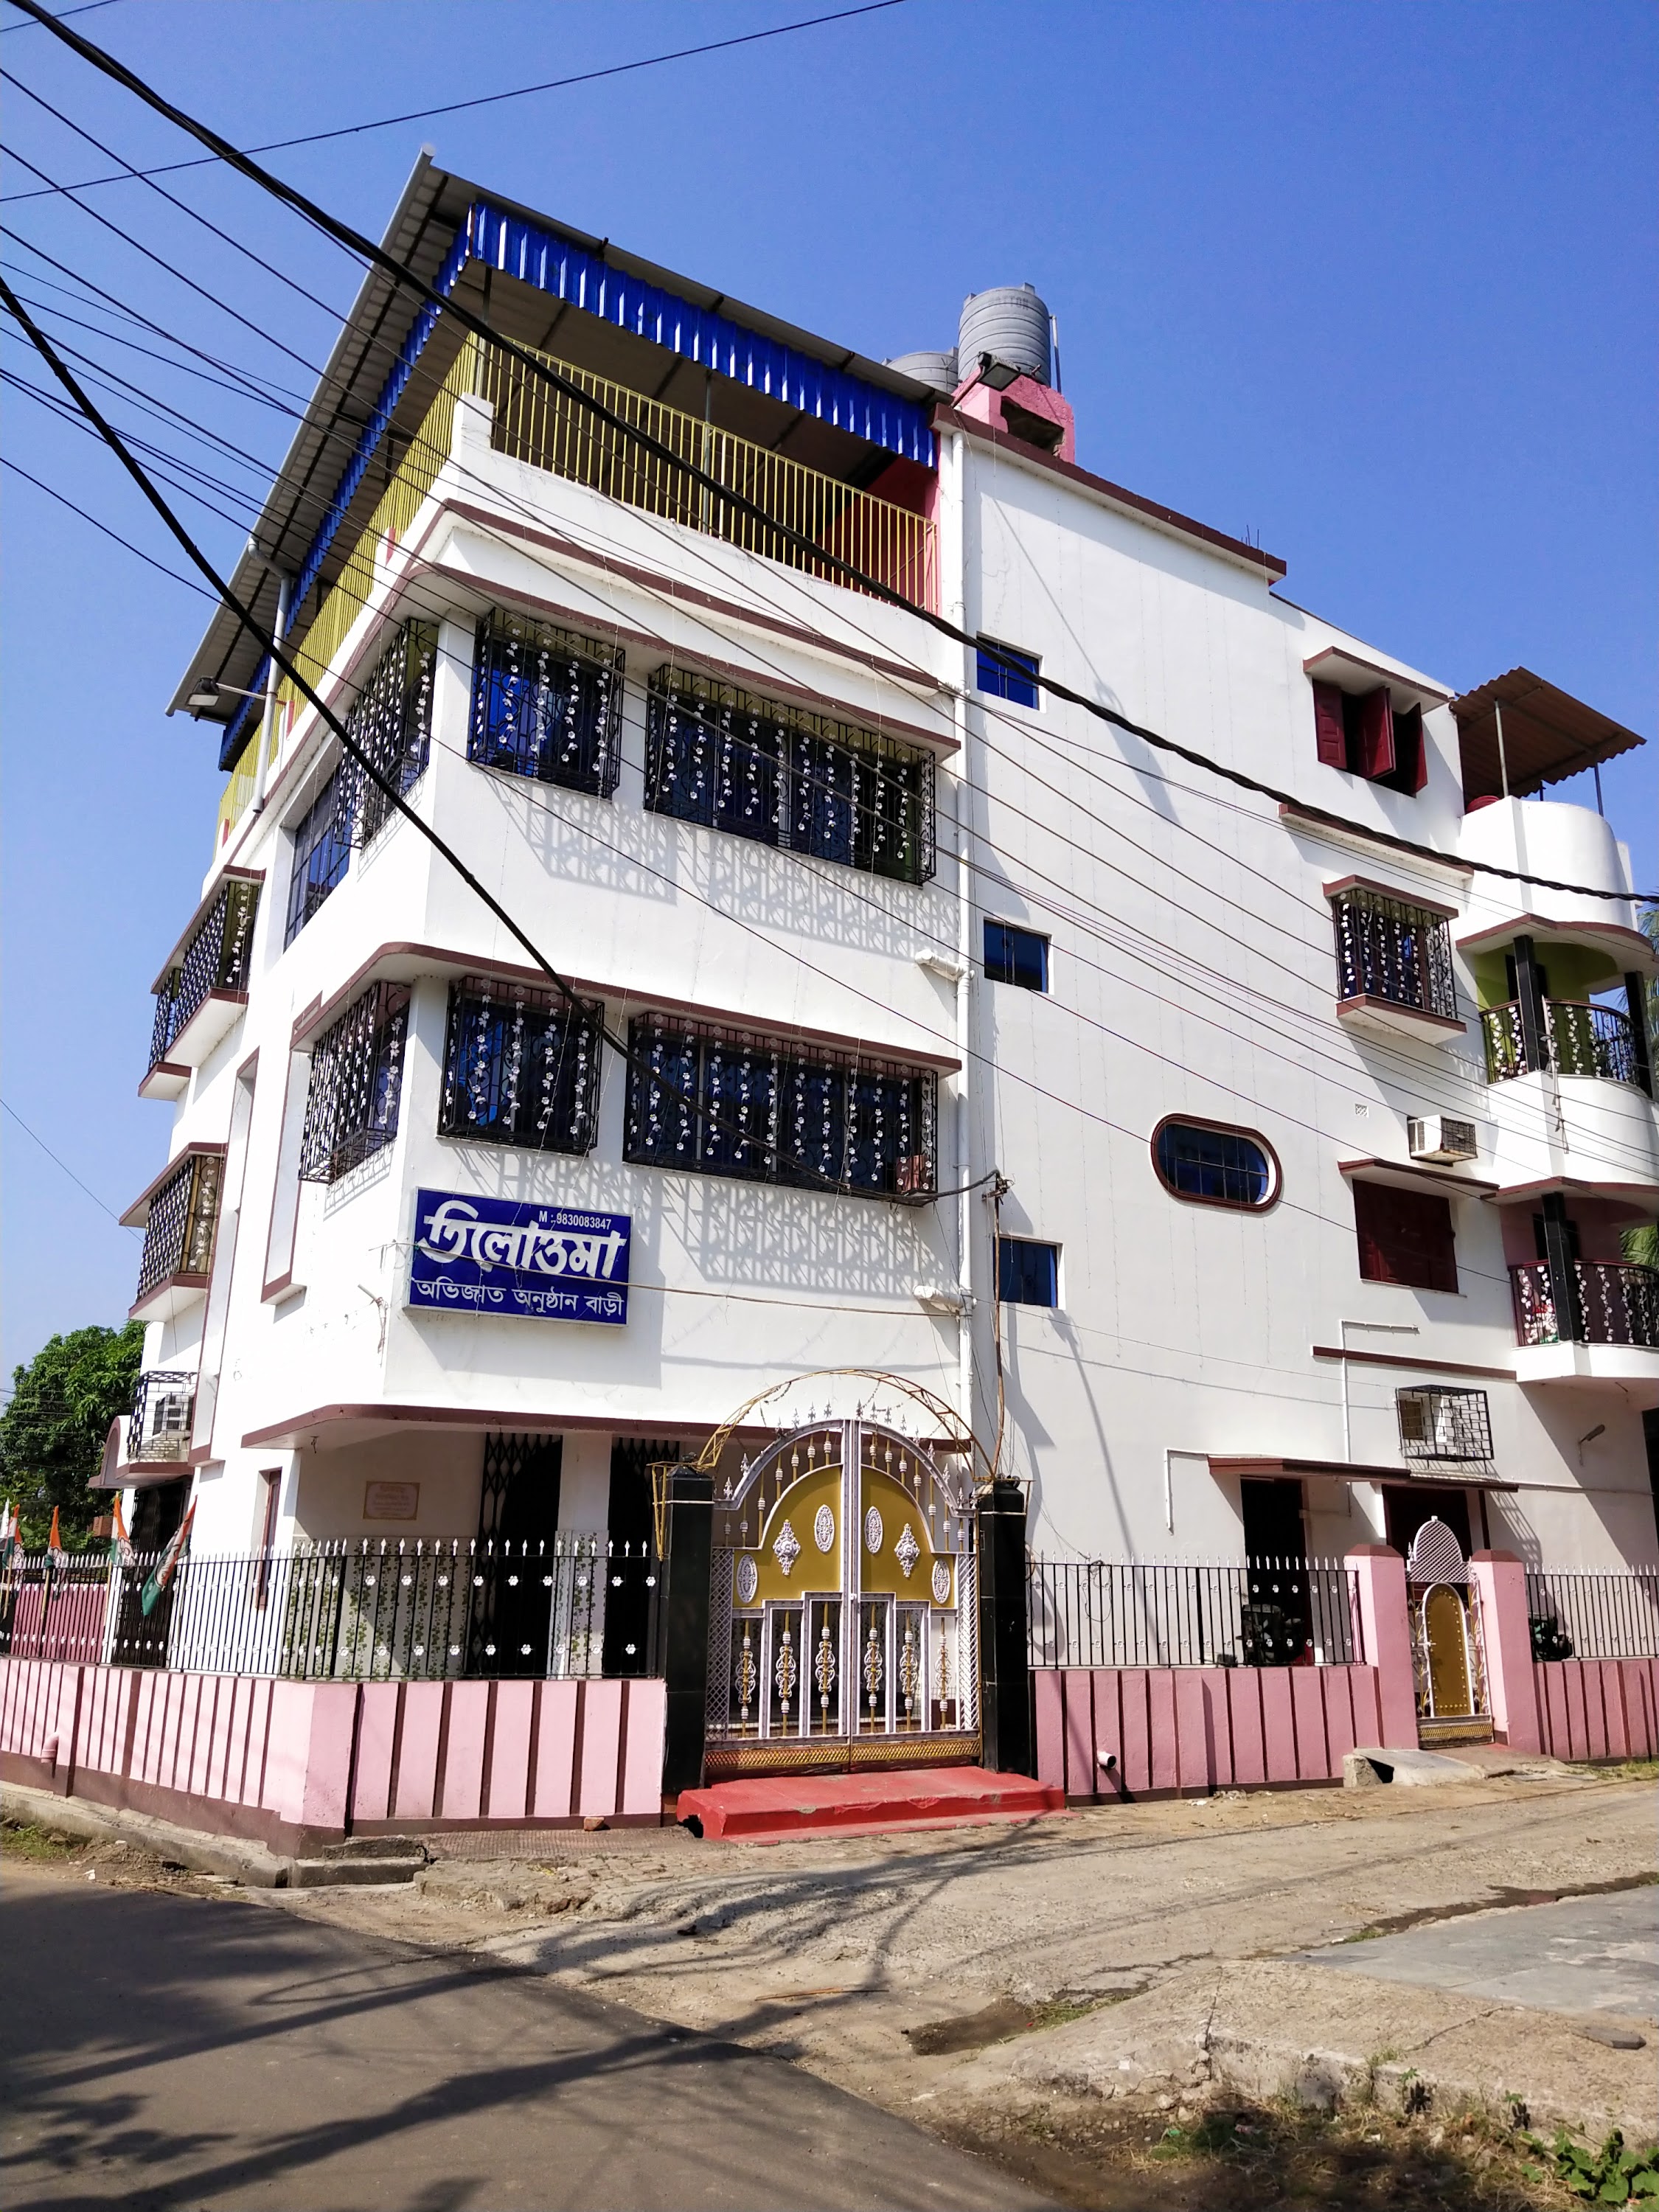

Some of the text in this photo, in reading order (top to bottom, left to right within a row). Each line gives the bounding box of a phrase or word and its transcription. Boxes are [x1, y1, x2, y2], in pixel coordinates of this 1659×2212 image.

[419, 1200, 627, 1279] তিলোত্তমা
[539, 1210, 548, 1222] M
[556, 1212, 612, 1230] 9830083847
[415, 1276, 625, 1316] অভিজাত অনুষ্ঠান বাড়ী
